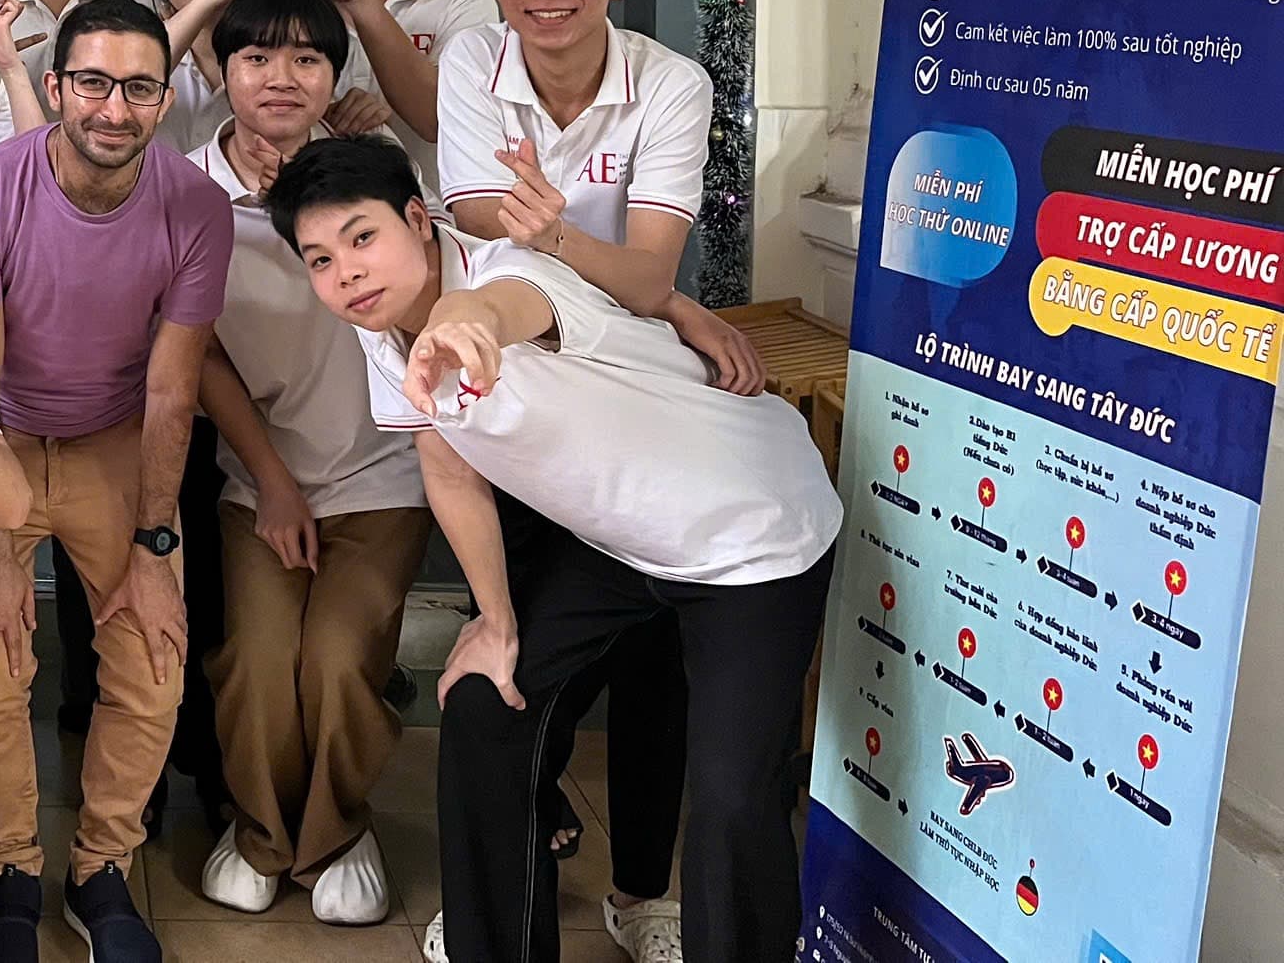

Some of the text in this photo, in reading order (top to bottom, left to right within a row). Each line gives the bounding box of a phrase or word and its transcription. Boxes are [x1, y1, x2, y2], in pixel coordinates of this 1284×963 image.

[955, 21, 1243, 65] Cam kết việc làm 100% sau tốt nghiệp
[950, 68, 1089, 101] Định cư sau 05 năm
[576, 152, 617, 184] AE
[914, 169, 984, 204] MIỄN PHÍ
[1095, 143, 1282, 205] MIỄN HỌC PHÍ
[918, 207, 950, 232] THỬ
[951, 217, 1010, 247] ONLINE
[1078, 215, 1280, 285] TRỢ CẤP LƯƠNG
[1109, 292, 1158, 328] CẤP
[1162, 307, 1237, 352] QUỐC
[1242, 324, 1278, 363] TẾ
[915, 332, 1176, 444] LỘ TRÌNH BAY SANG TÂY ĐỨC
[874, 906, 900, 938] TRUNG
[901, 932, 917, 955] TÂM
